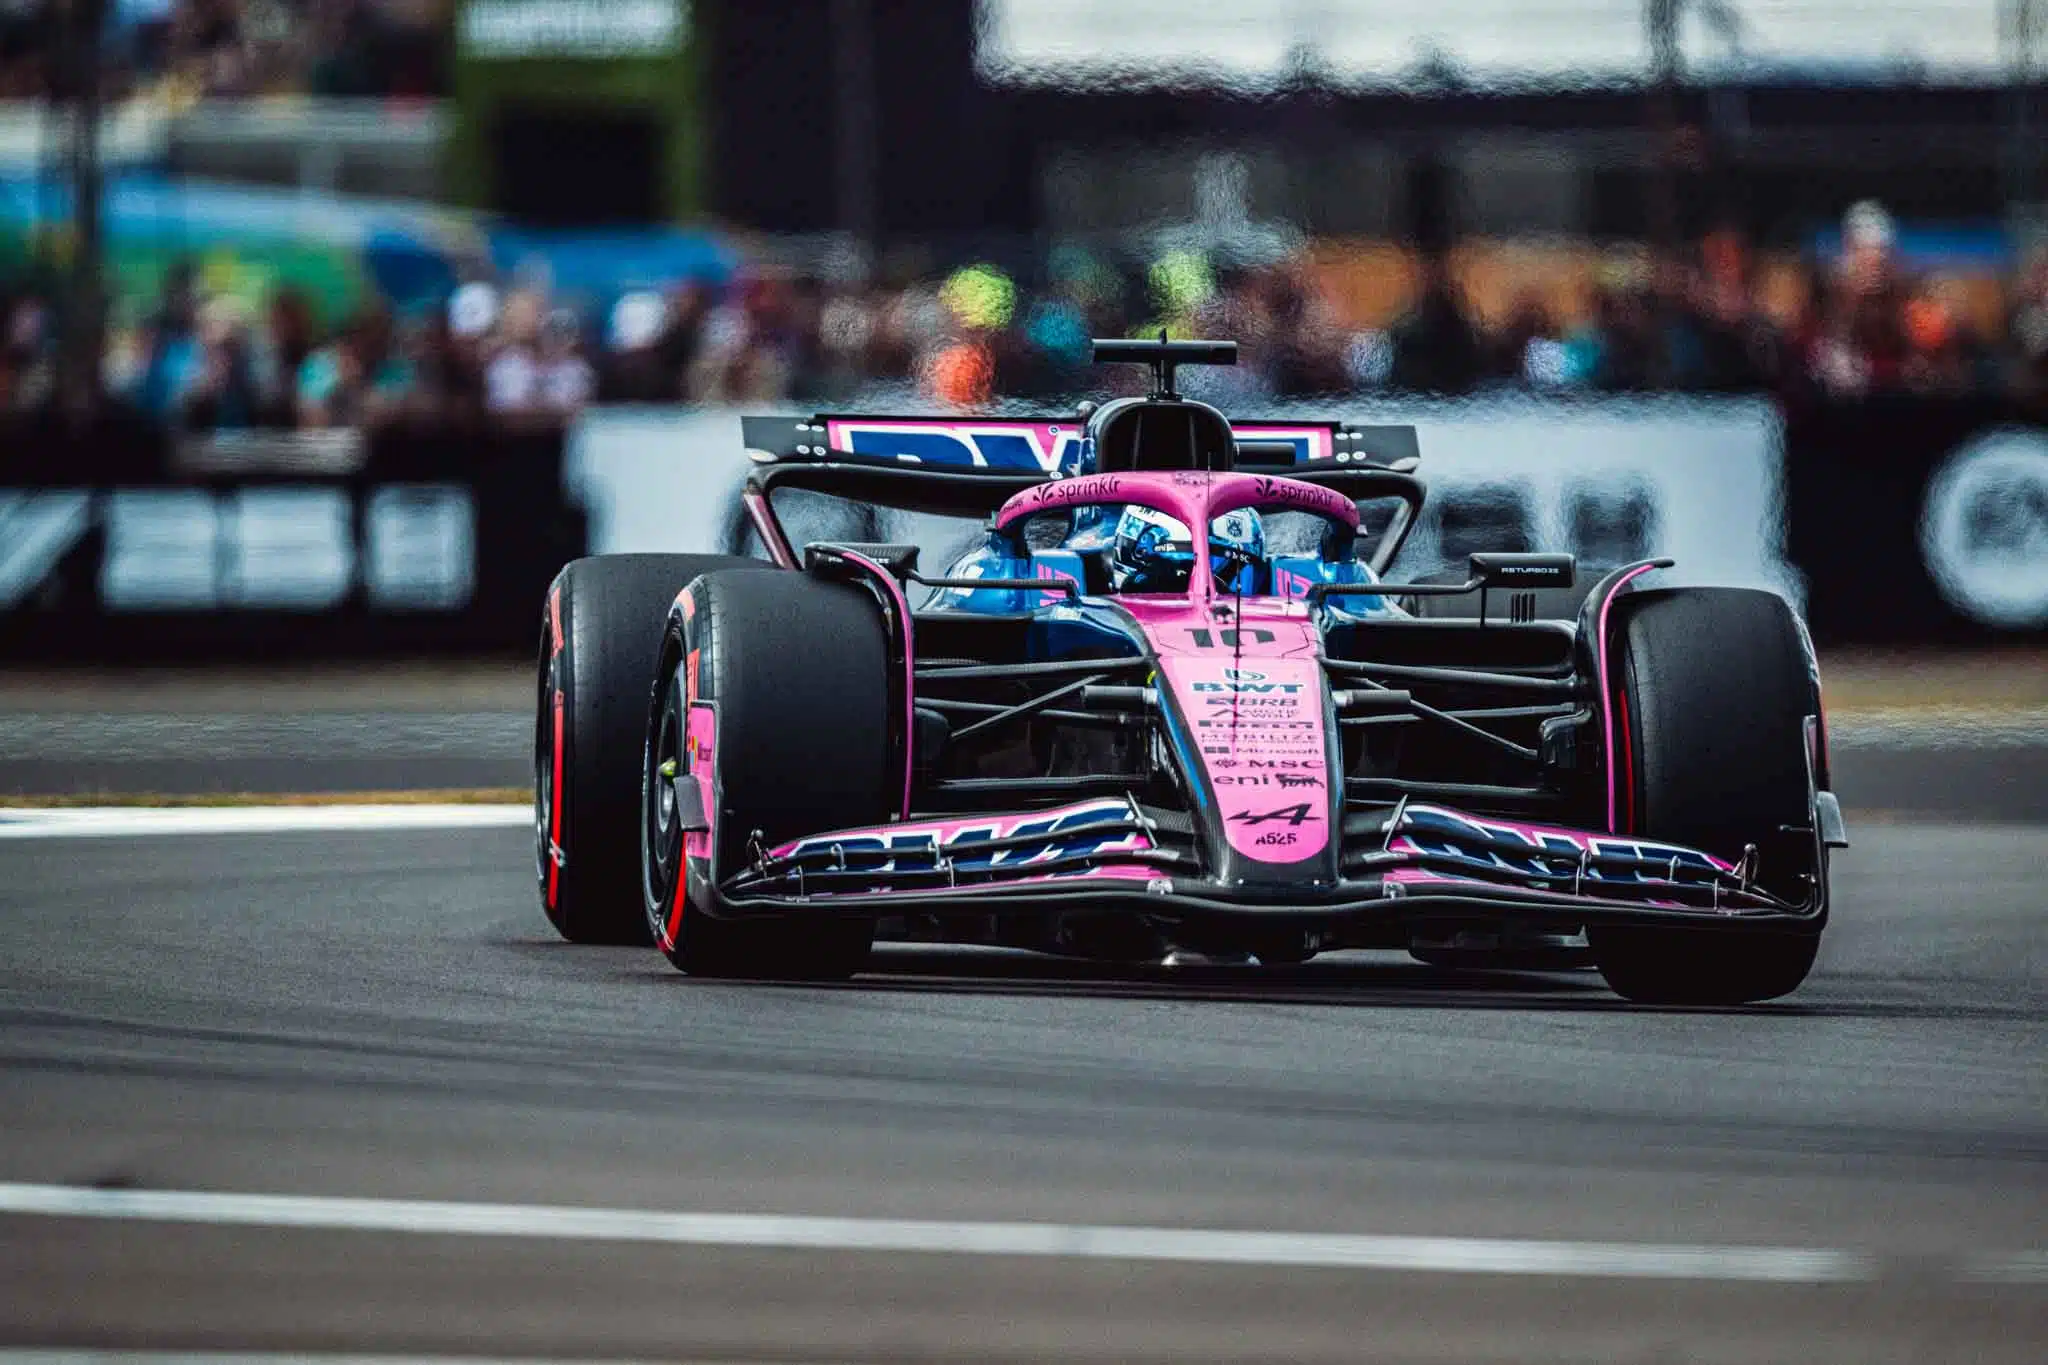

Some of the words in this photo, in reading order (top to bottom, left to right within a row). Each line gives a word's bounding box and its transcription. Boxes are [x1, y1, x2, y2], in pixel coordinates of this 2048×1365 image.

[1058, 476, 1121, 503] sprinklr
[1280, 484, 1334, 505] sprinklr
[1192, 682, 1304, 693] BWT
[1249, 760, 1324, 769] MSC
[1214, 773, 1269, 785] eni
